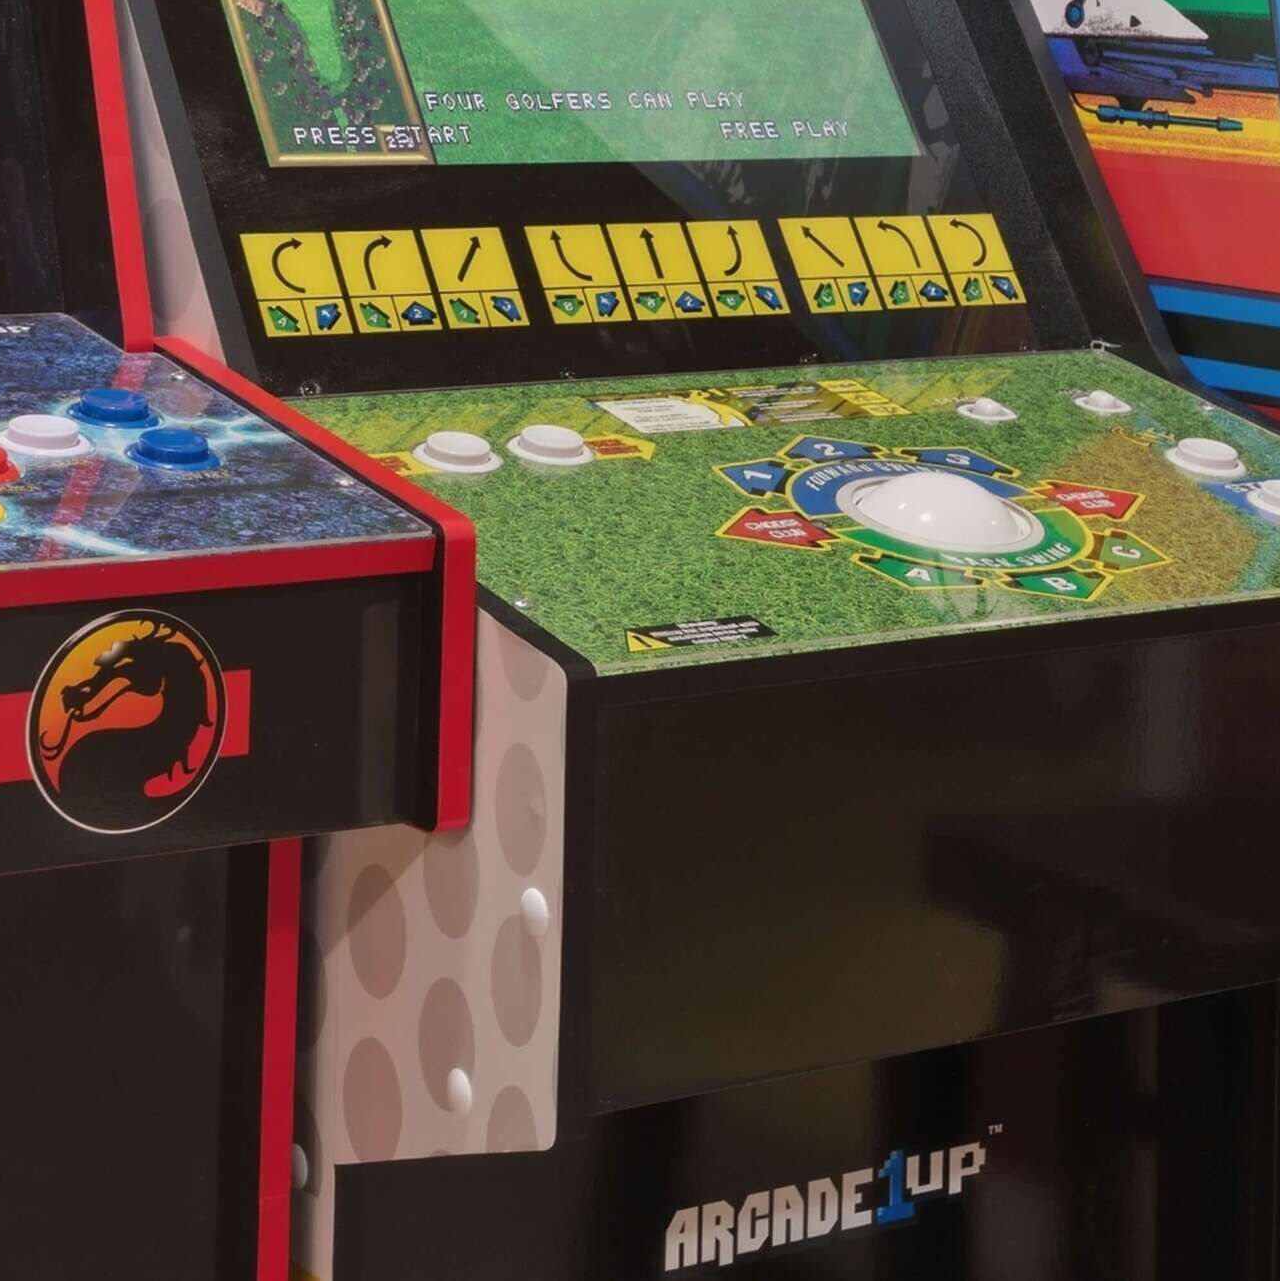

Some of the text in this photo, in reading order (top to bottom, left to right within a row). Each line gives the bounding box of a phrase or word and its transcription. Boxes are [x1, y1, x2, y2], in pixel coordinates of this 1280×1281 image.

[424, 91, 747, 111] FOUR GOLFERS CAN PLAY
[293, 126, 377, 145] PRESS
[394, 124, 471, 145] START
[720, 121, 781, 139] FREE
[793, 119, 850, 138] PLAY
[813, 443, 845, 456] 2
[743, 469, 773, 481] 1
[1015, 541, 1073, 568] SWING
[1111, 545, 1142, 559] C
[904, 568, 932, 582] A
[1042, 576, 1077, 592] B
[663, 1140, 987, 1273] ARCADE1UP
